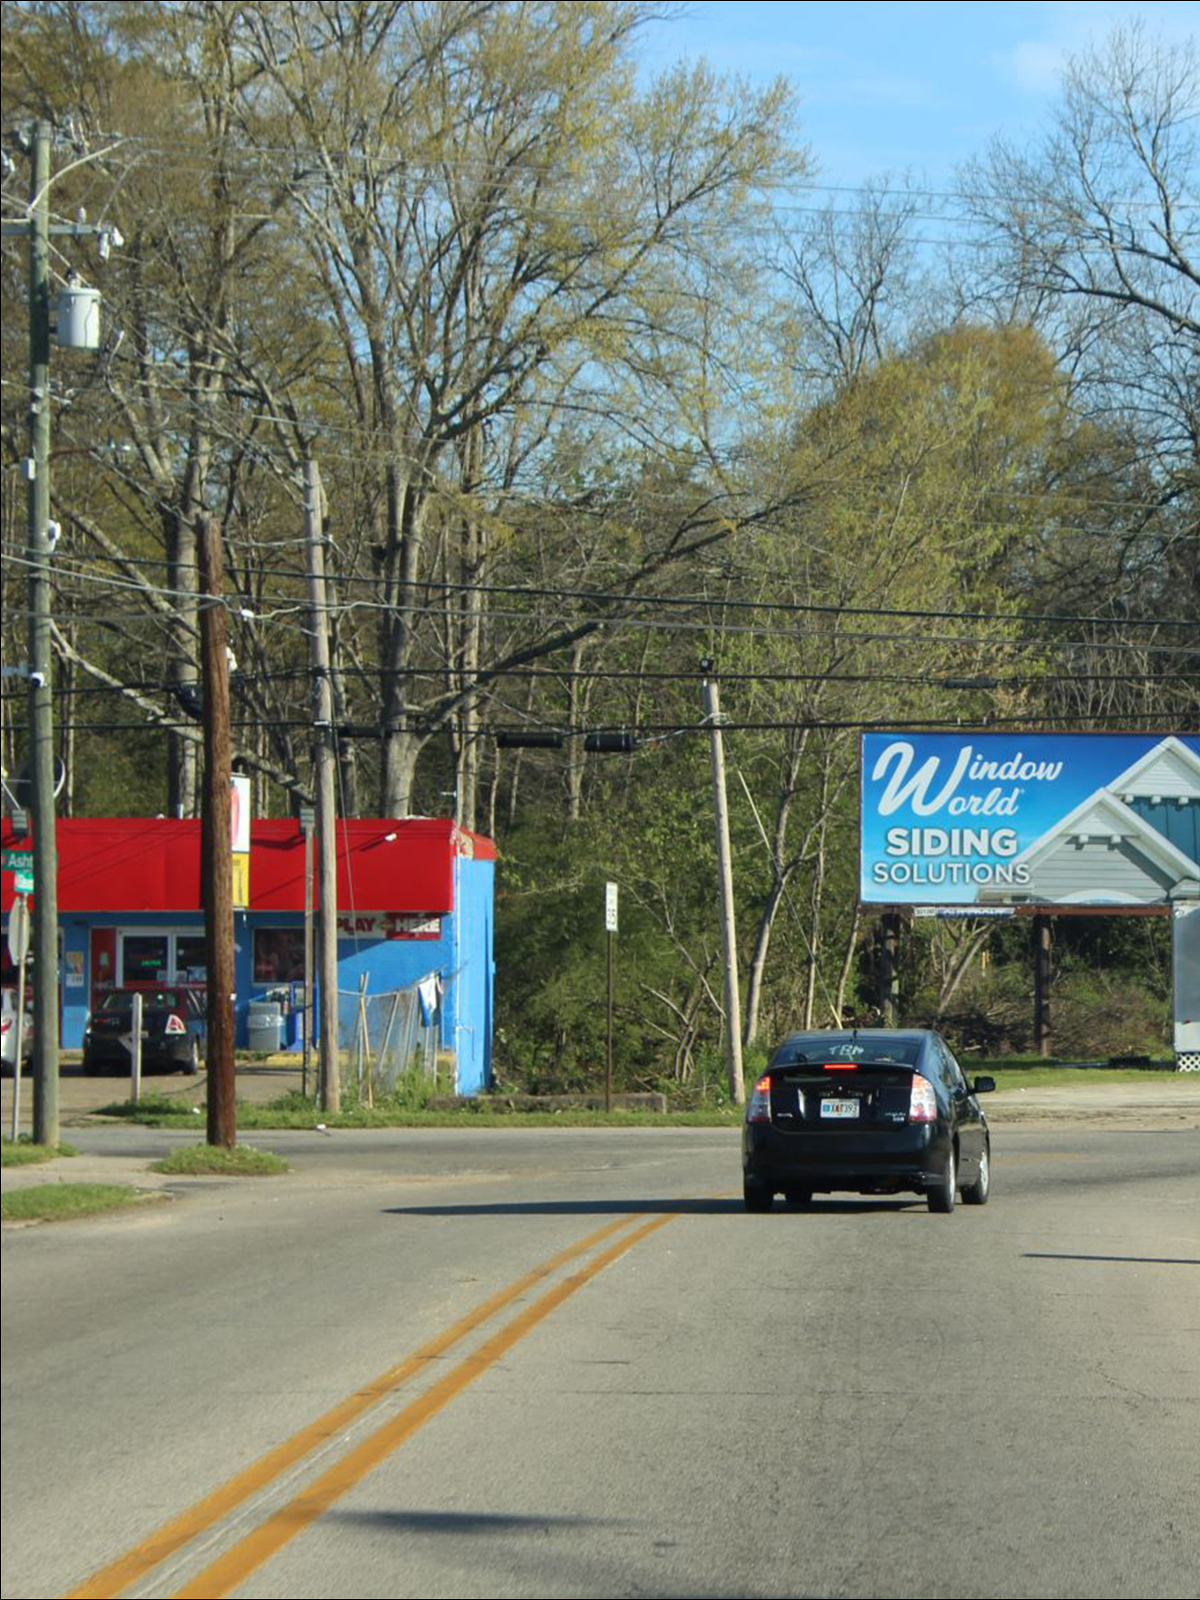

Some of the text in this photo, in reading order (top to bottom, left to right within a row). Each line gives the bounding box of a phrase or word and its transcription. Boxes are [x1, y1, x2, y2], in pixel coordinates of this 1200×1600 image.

[872, 741, 1063, 816] Window
[886, 828, 1018, 857] SIDING
[873, 863, 1030, 885] SOLUTIONS
[396, 918, 440, 932] HERE
